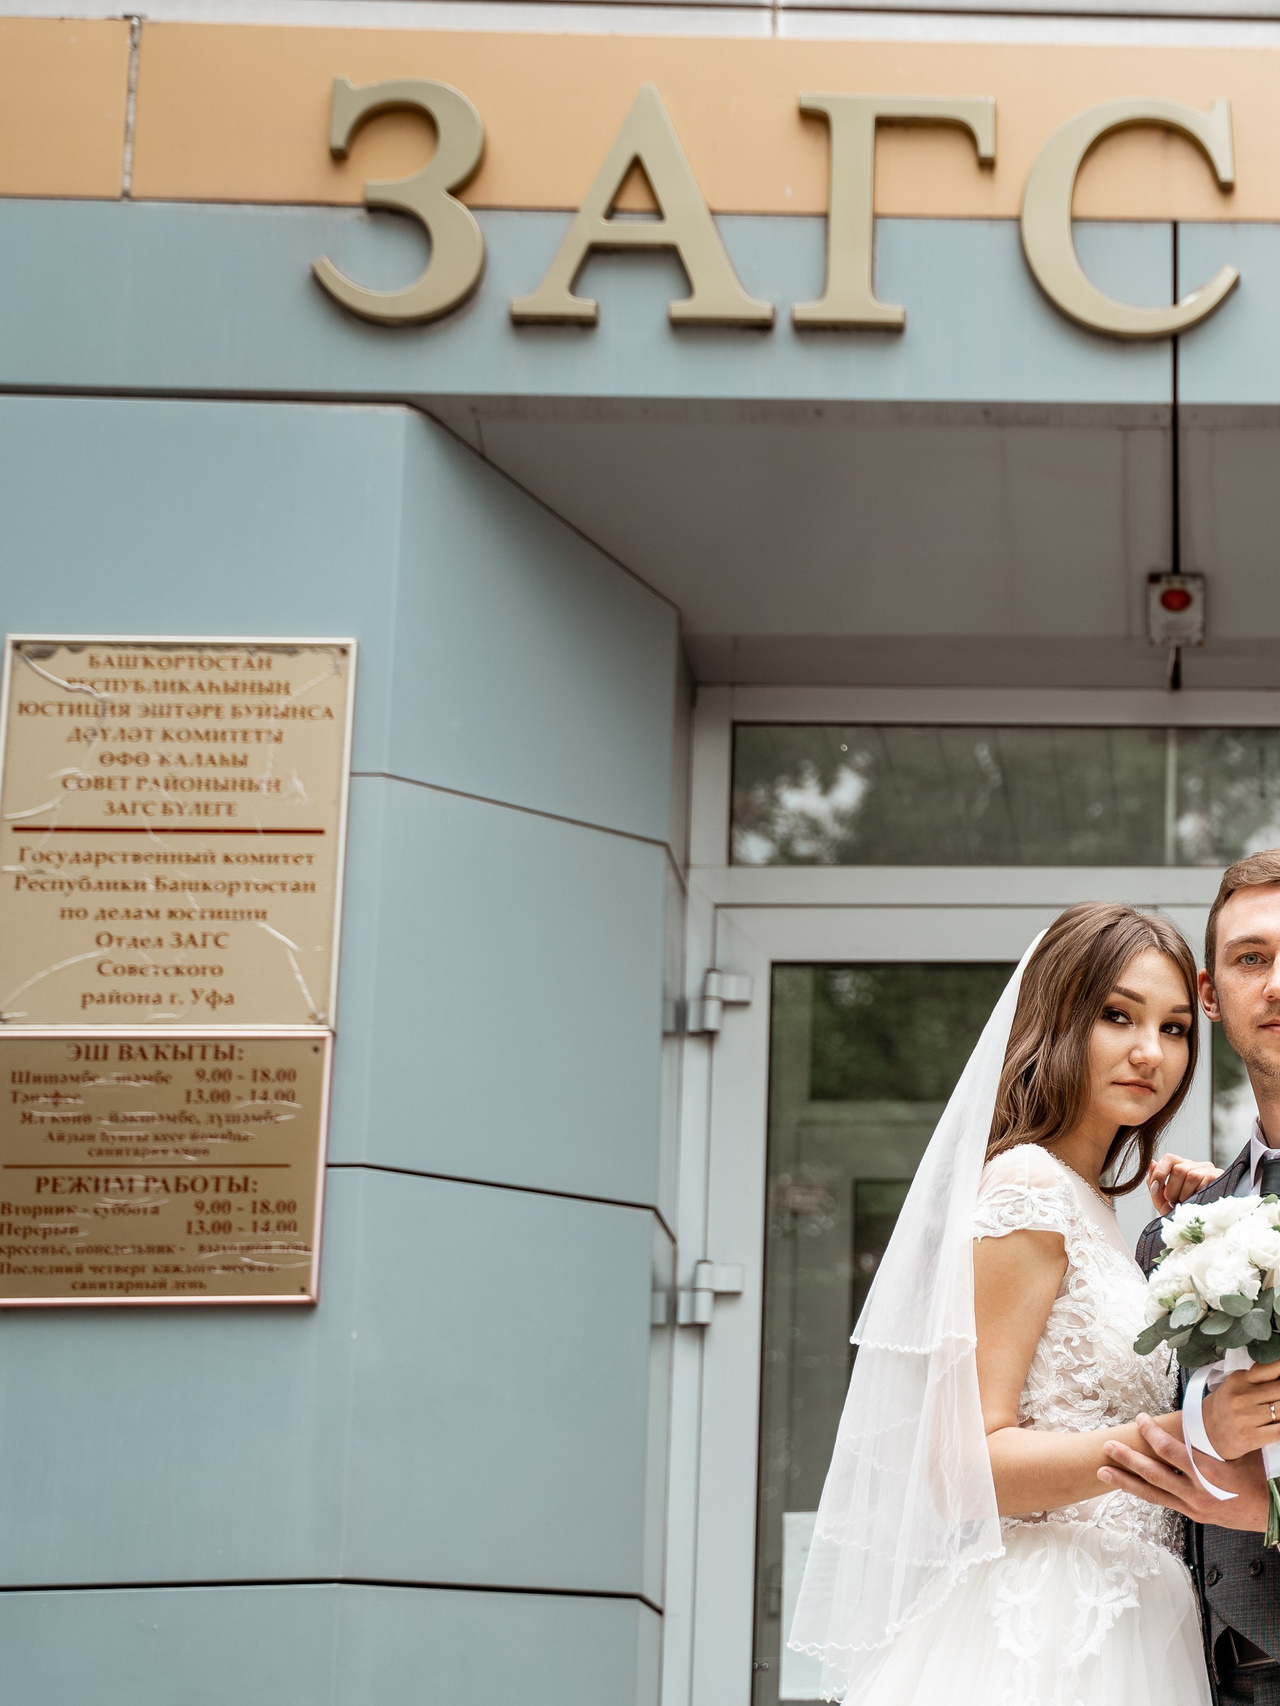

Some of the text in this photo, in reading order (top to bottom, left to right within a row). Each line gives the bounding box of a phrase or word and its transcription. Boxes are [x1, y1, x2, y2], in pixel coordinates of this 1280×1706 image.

[311, 76, 1240, 341] ЗАГС
[18, 701, 131, 718] ЮСТИЦИЯ
[160, 727, 284, 744] КОМИТЕТЫ
[61, 776, 132, 792] СОВЕТ
[103, 801, 154, 817] ЗАГС
[18, 845, 315, 869] Государственный комитет
[14, 874, 316, 898] Республики Башкортостан
[59, 907, 268, 922] по делам юстиции
[95, 931, 230, 950] Отдел ЗАГС
[96, 959, 225, 978] Советского
[80, 988, 236, 1011] района г. Уфа
[66, 1043, 112, 1062] ЭШ
[194, 1067, 233, 1083] 9.00
[250, 1067, 298, 1083] 18.00
[185, 1088, 232, 1104] 13.00
[249, 1088, 297, 1103] 14.00
[35, 1176, 135, 1194] РЕЖИМ
[0, 1202, 77, 1219] Вторник
[93, 1203, 160, 1219] суббота
[194, 1199, 232, 1215] 9.00
[251, 1199, 298, 1214] 18.00
[0, 1221, 79, 1239] Перерыв
[186, 1219, 232, 1235] 13.00
[251, 1219, 298, 1233] 14.00
[89, 1264, 146, 1277] четверг
